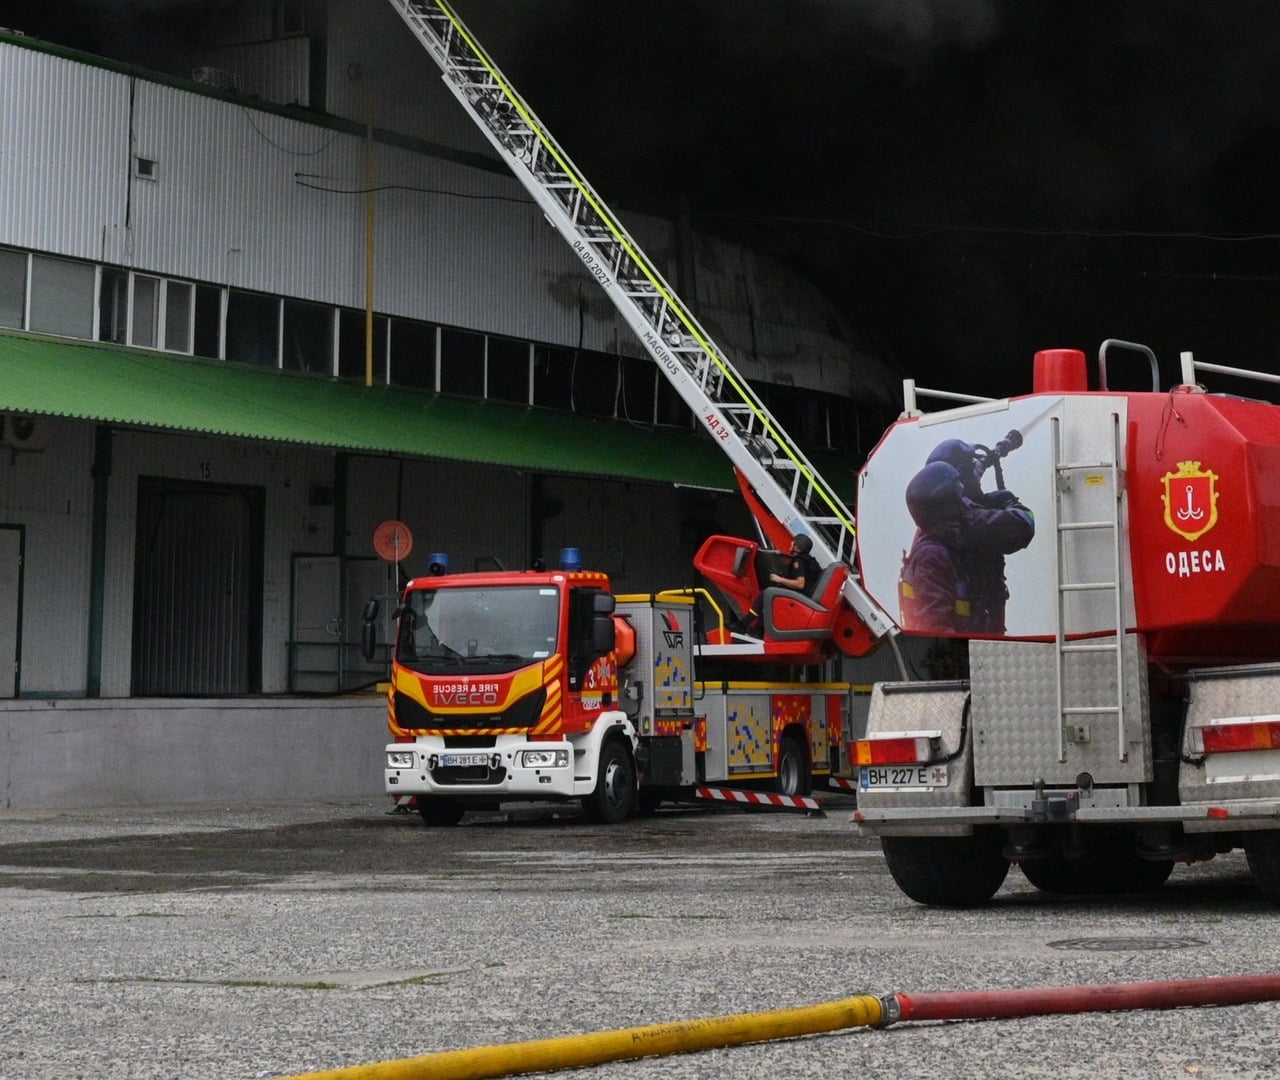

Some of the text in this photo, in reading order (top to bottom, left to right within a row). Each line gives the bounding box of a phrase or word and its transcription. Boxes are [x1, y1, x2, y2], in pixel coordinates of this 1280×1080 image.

[643, 331, 680, 376] MAGIRUS
[705, 414, 729, 441] АД 32
[200, 461, 211, 479] 15
[1165, 549, 1226, 578] ОДЕСА
[588, 669, 595, 689] 3
[434, 692, 497, 705] IVECO
[869, 768, 928, 785] BH 227 E
